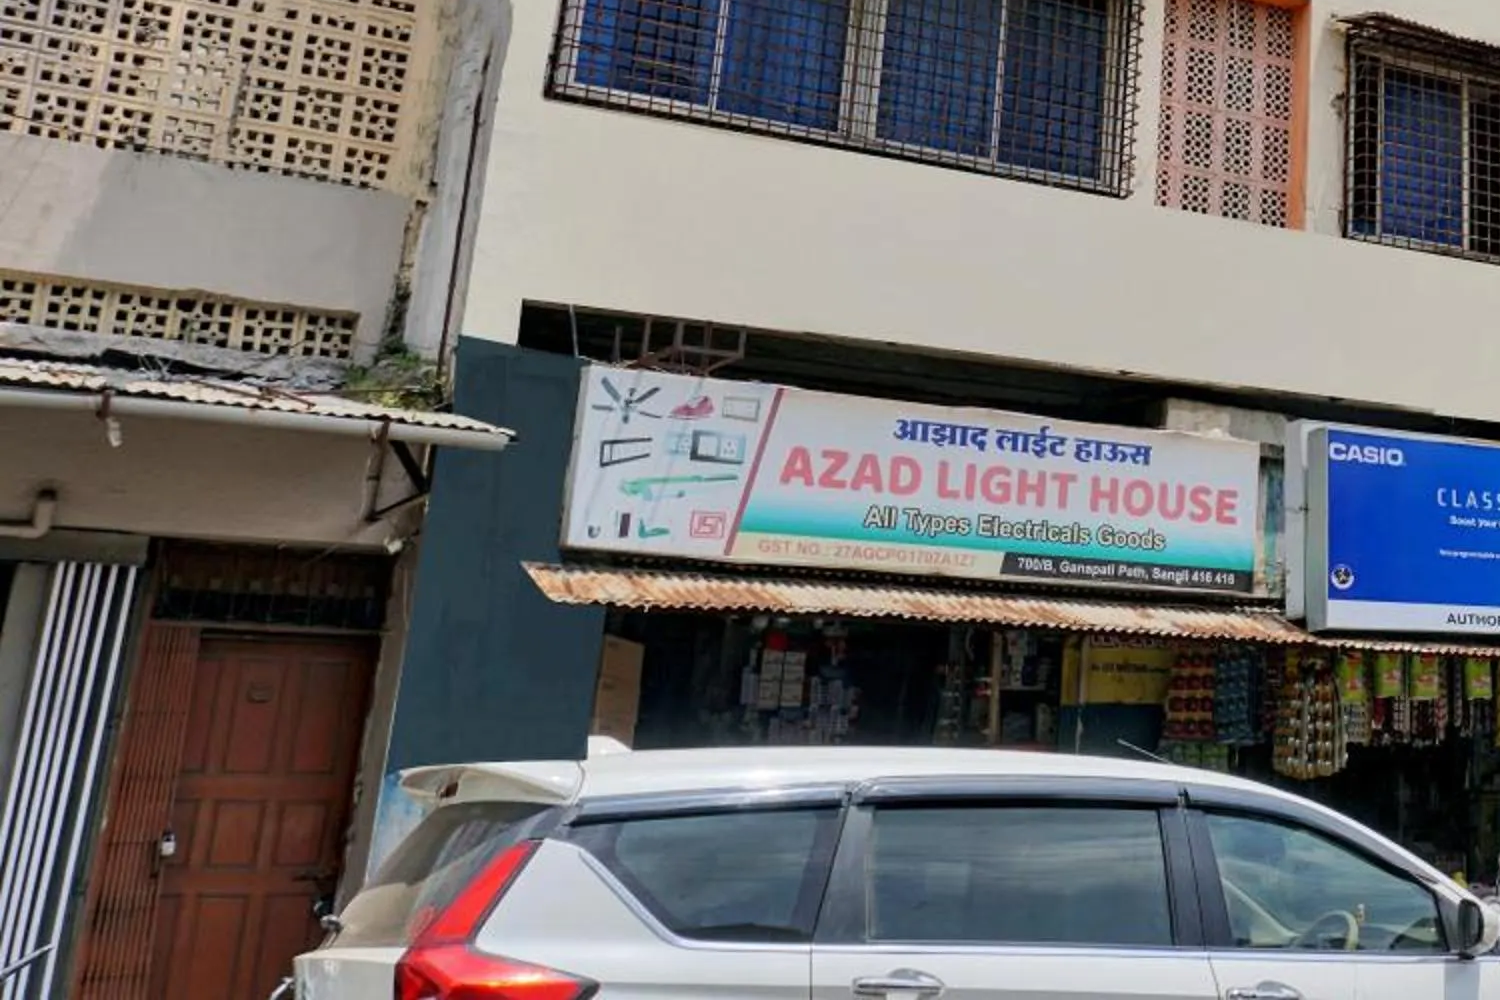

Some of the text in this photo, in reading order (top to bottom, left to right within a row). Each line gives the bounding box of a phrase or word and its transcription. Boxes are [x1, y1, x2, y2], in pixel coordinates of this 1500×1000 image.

[893, 418, 1153, 465] आझाद लाईट हाऊस
[1329, 441, 1405, 467] CASIO
[779, 446, 1240, 526] AZAD LIGHT HOUSE
[863, 504, 1167, 552] All Types Electricals Goods
[1060, 561, 1115, 580] Ganapati
